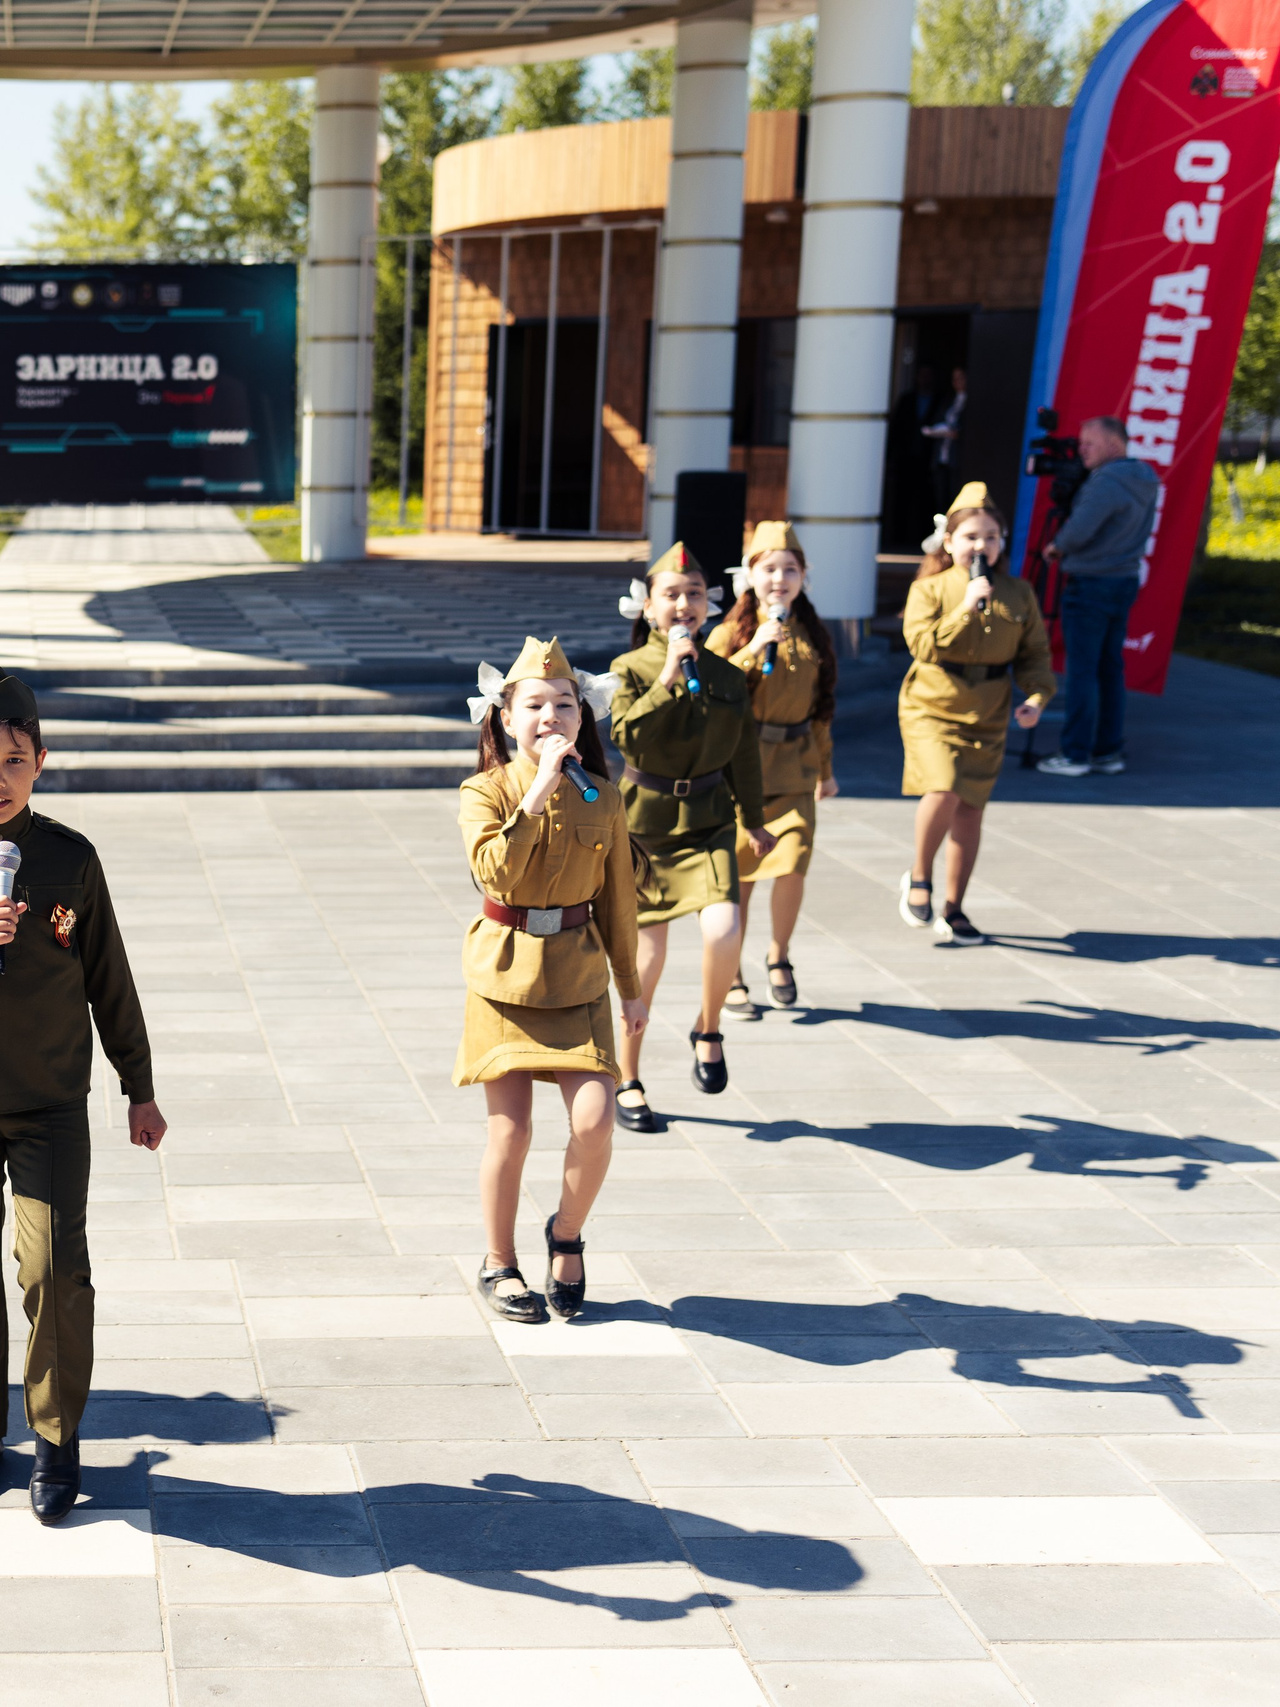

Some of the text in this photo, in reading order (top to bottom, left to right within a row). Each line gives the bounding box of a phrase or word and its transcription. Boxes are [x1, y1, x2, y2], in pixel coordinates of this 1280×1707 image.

[16, 354, 218, 385] ЗАРНИЦА 2.0
[1125, 140, 1232, 589] НИЦА 2.0
